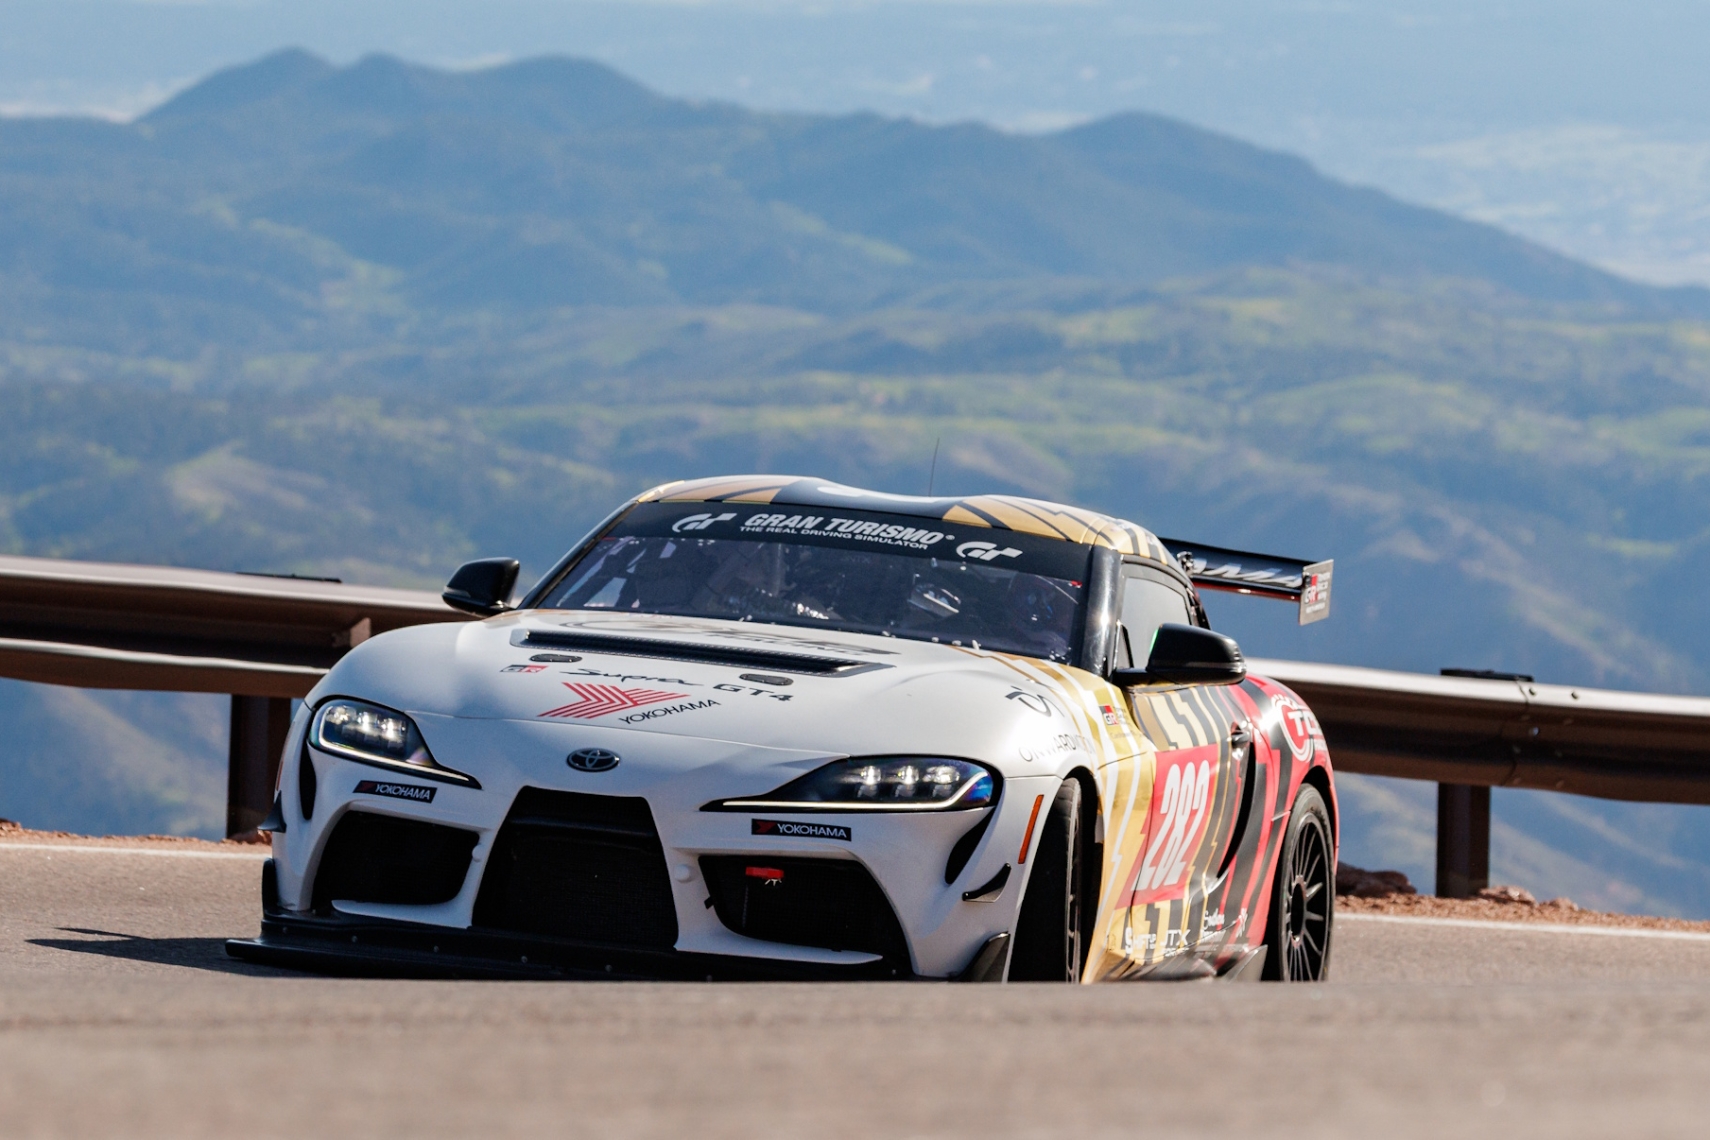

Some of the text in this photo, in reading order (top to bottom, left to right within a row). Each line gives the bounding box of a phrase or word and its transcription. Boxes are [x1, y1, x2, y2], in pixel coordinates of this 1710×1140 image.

[744, 513, 945, 545] GRAN TURISMO
[765, 526, 798, 535] REAL
[800, 529, 852, 539] DRIVING
[854, 534, 929, 550] SIMULATOR
[559, 668, 705, 687] Supra
[712, 683, 795, 702] GT4
[618, 699, 722, 725] YOKOHAMA
[376, 784, 431, 799] YOKOHAMA
[777, 823, 847, 838] YOKOHAMA
[1130, 760, 1211, 891] 282
